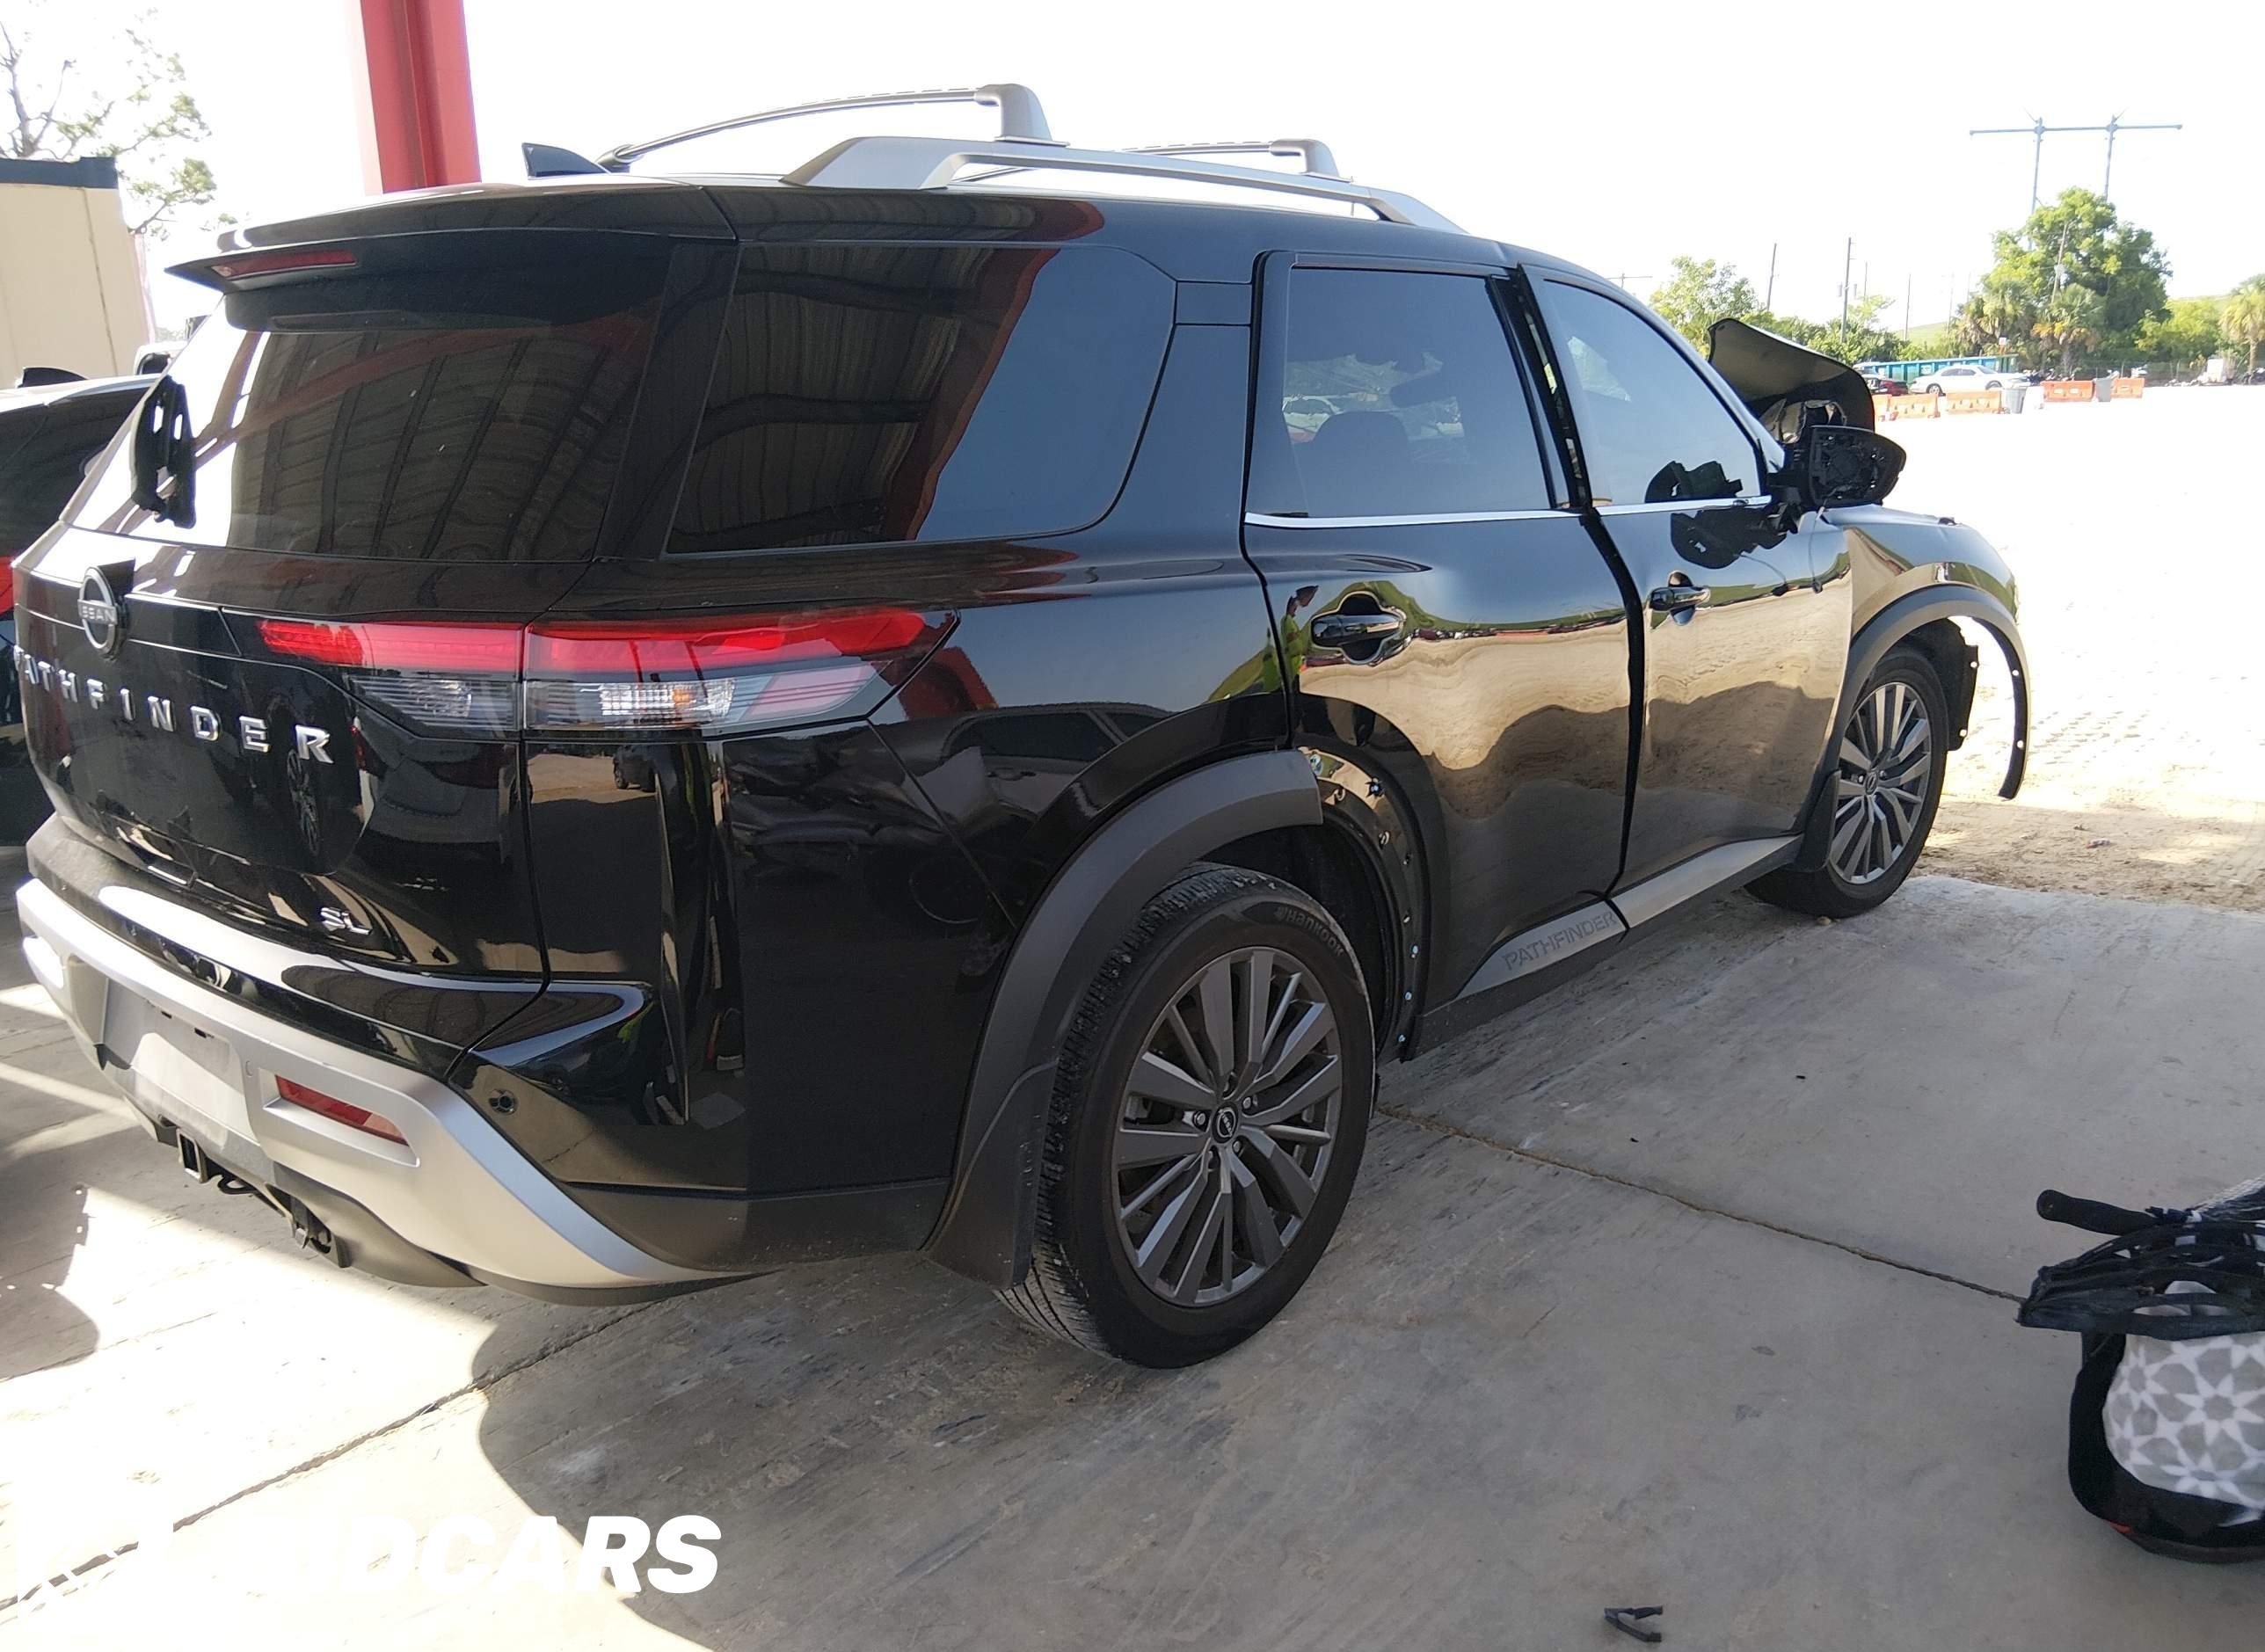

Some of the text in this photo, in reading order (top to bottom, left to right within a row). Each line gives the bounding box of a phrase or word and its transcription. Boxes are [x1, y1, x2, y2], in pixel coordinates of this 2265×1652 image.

[78, 603, 117, 623] SSAN
[321, 907, 372, 935] SL
[1501, 911, 1619, 971] PATHFINDER
